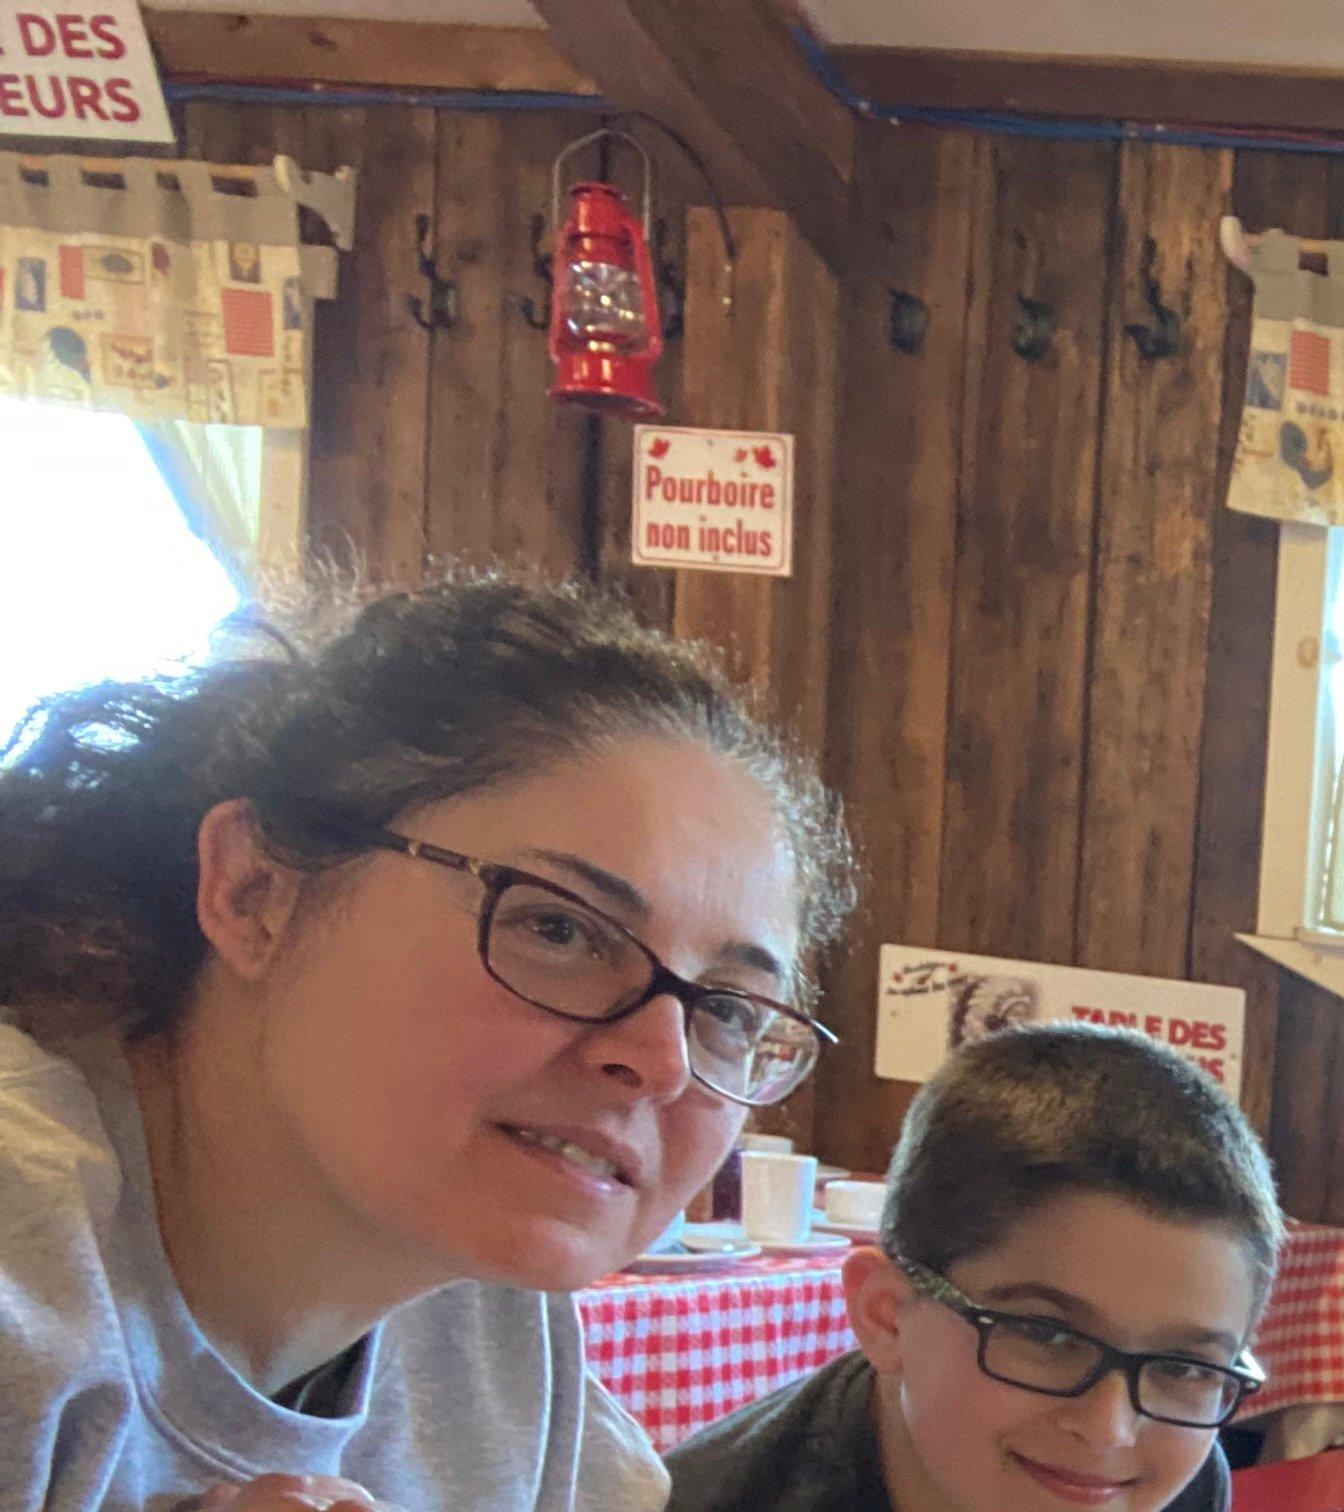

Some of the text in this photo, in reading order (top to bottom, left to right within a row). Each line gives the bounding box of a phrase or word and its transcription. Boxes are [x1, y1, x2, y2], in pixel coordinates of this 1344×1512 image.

[16, 13, 126, 60] DES
[646, 465, 774, 509] Pourboire
[647, 516, 772, 557] non inclus
[1168, 1018, 1226, 1051] DES
